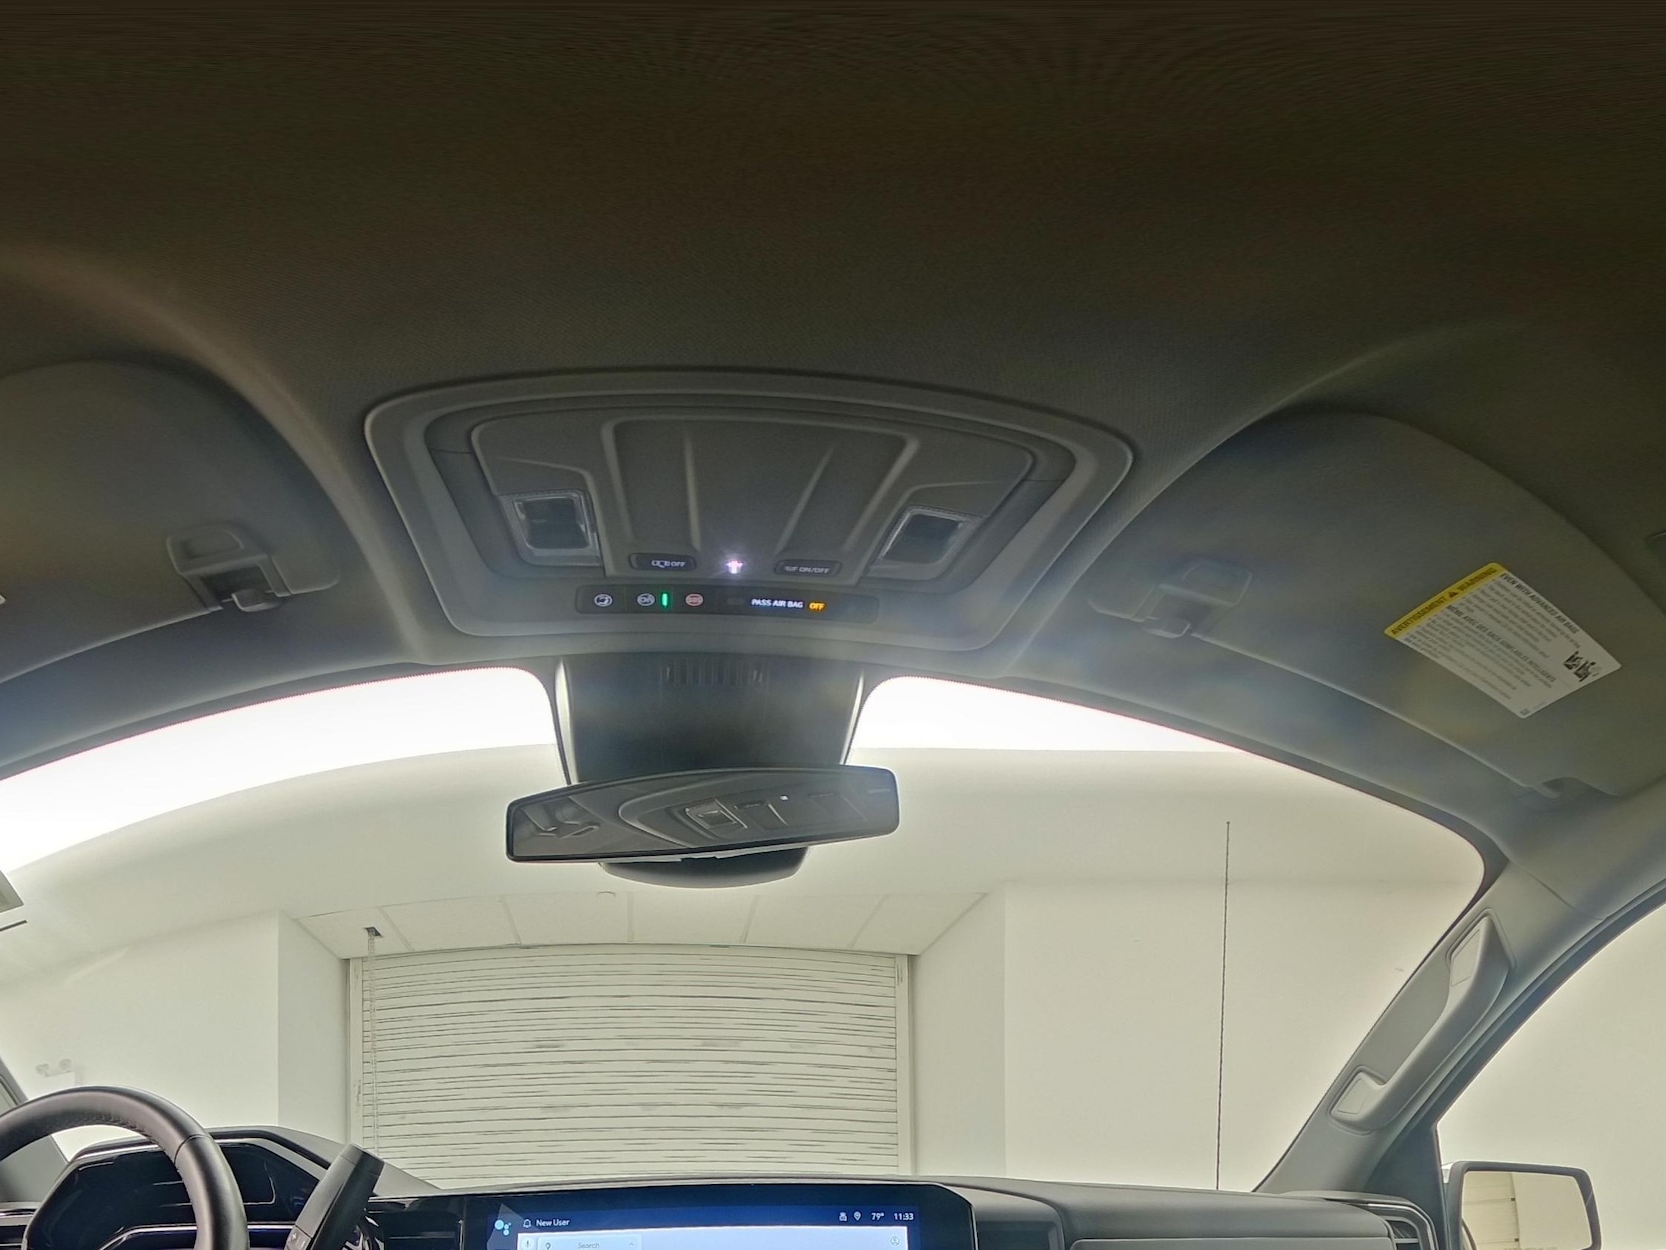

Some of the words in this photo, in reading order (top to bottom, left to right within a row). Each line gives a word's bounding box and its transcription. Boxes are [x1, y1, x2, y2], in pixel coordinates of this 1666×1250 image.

[788, 600, 803, 608] BAG
[894, 1212, 914, 1220] 11:33
[553, 1218, 570, 1226] User
